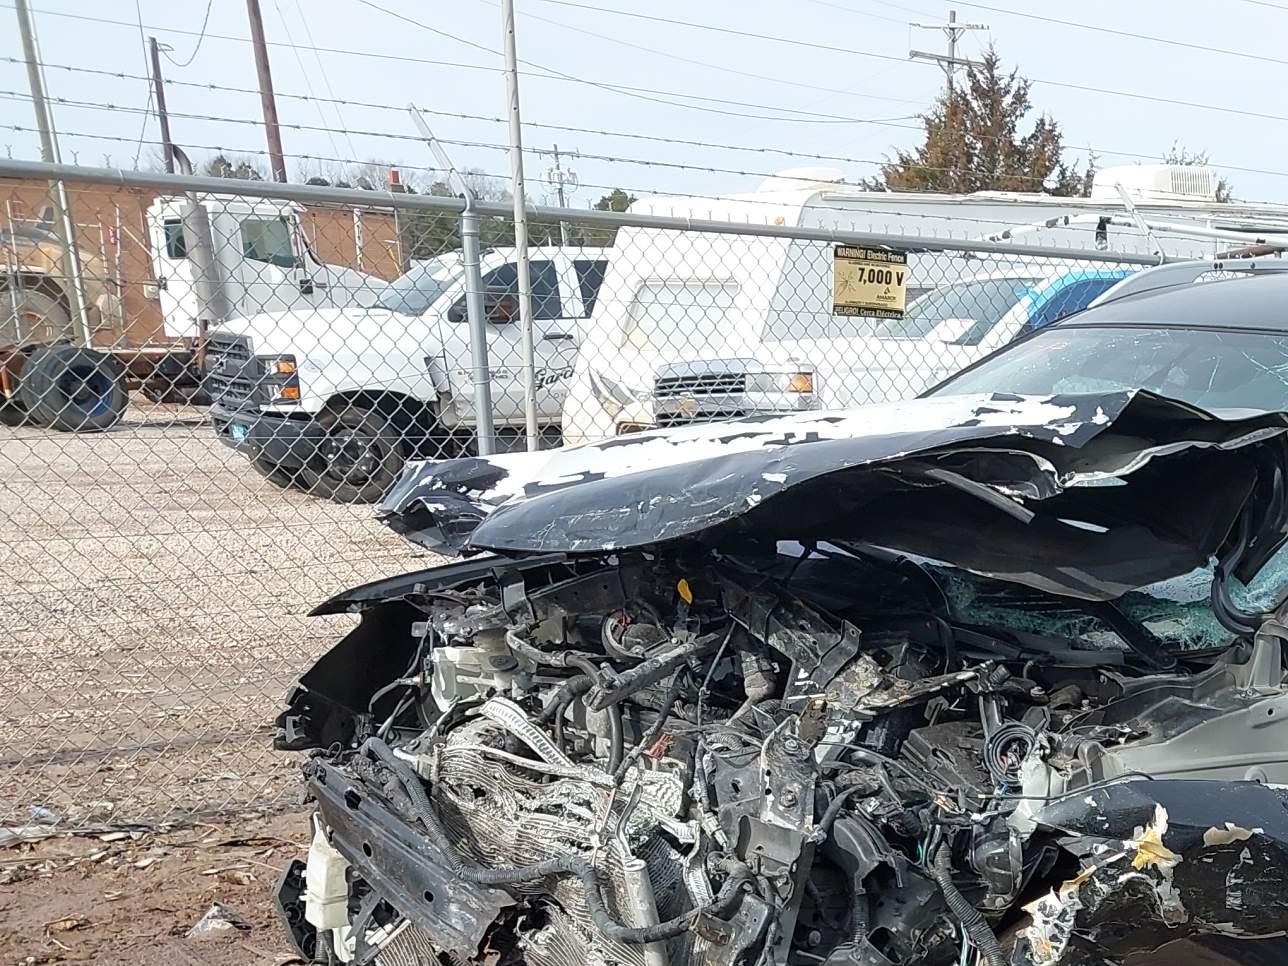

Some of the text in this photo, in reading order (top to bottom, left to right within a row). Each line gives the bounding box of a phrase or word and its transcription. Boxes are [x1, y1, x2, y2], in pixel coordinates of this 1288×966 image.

[837, 247, 866, 258] WARNING!
[858, 267, 904, 286] 7,000 V
